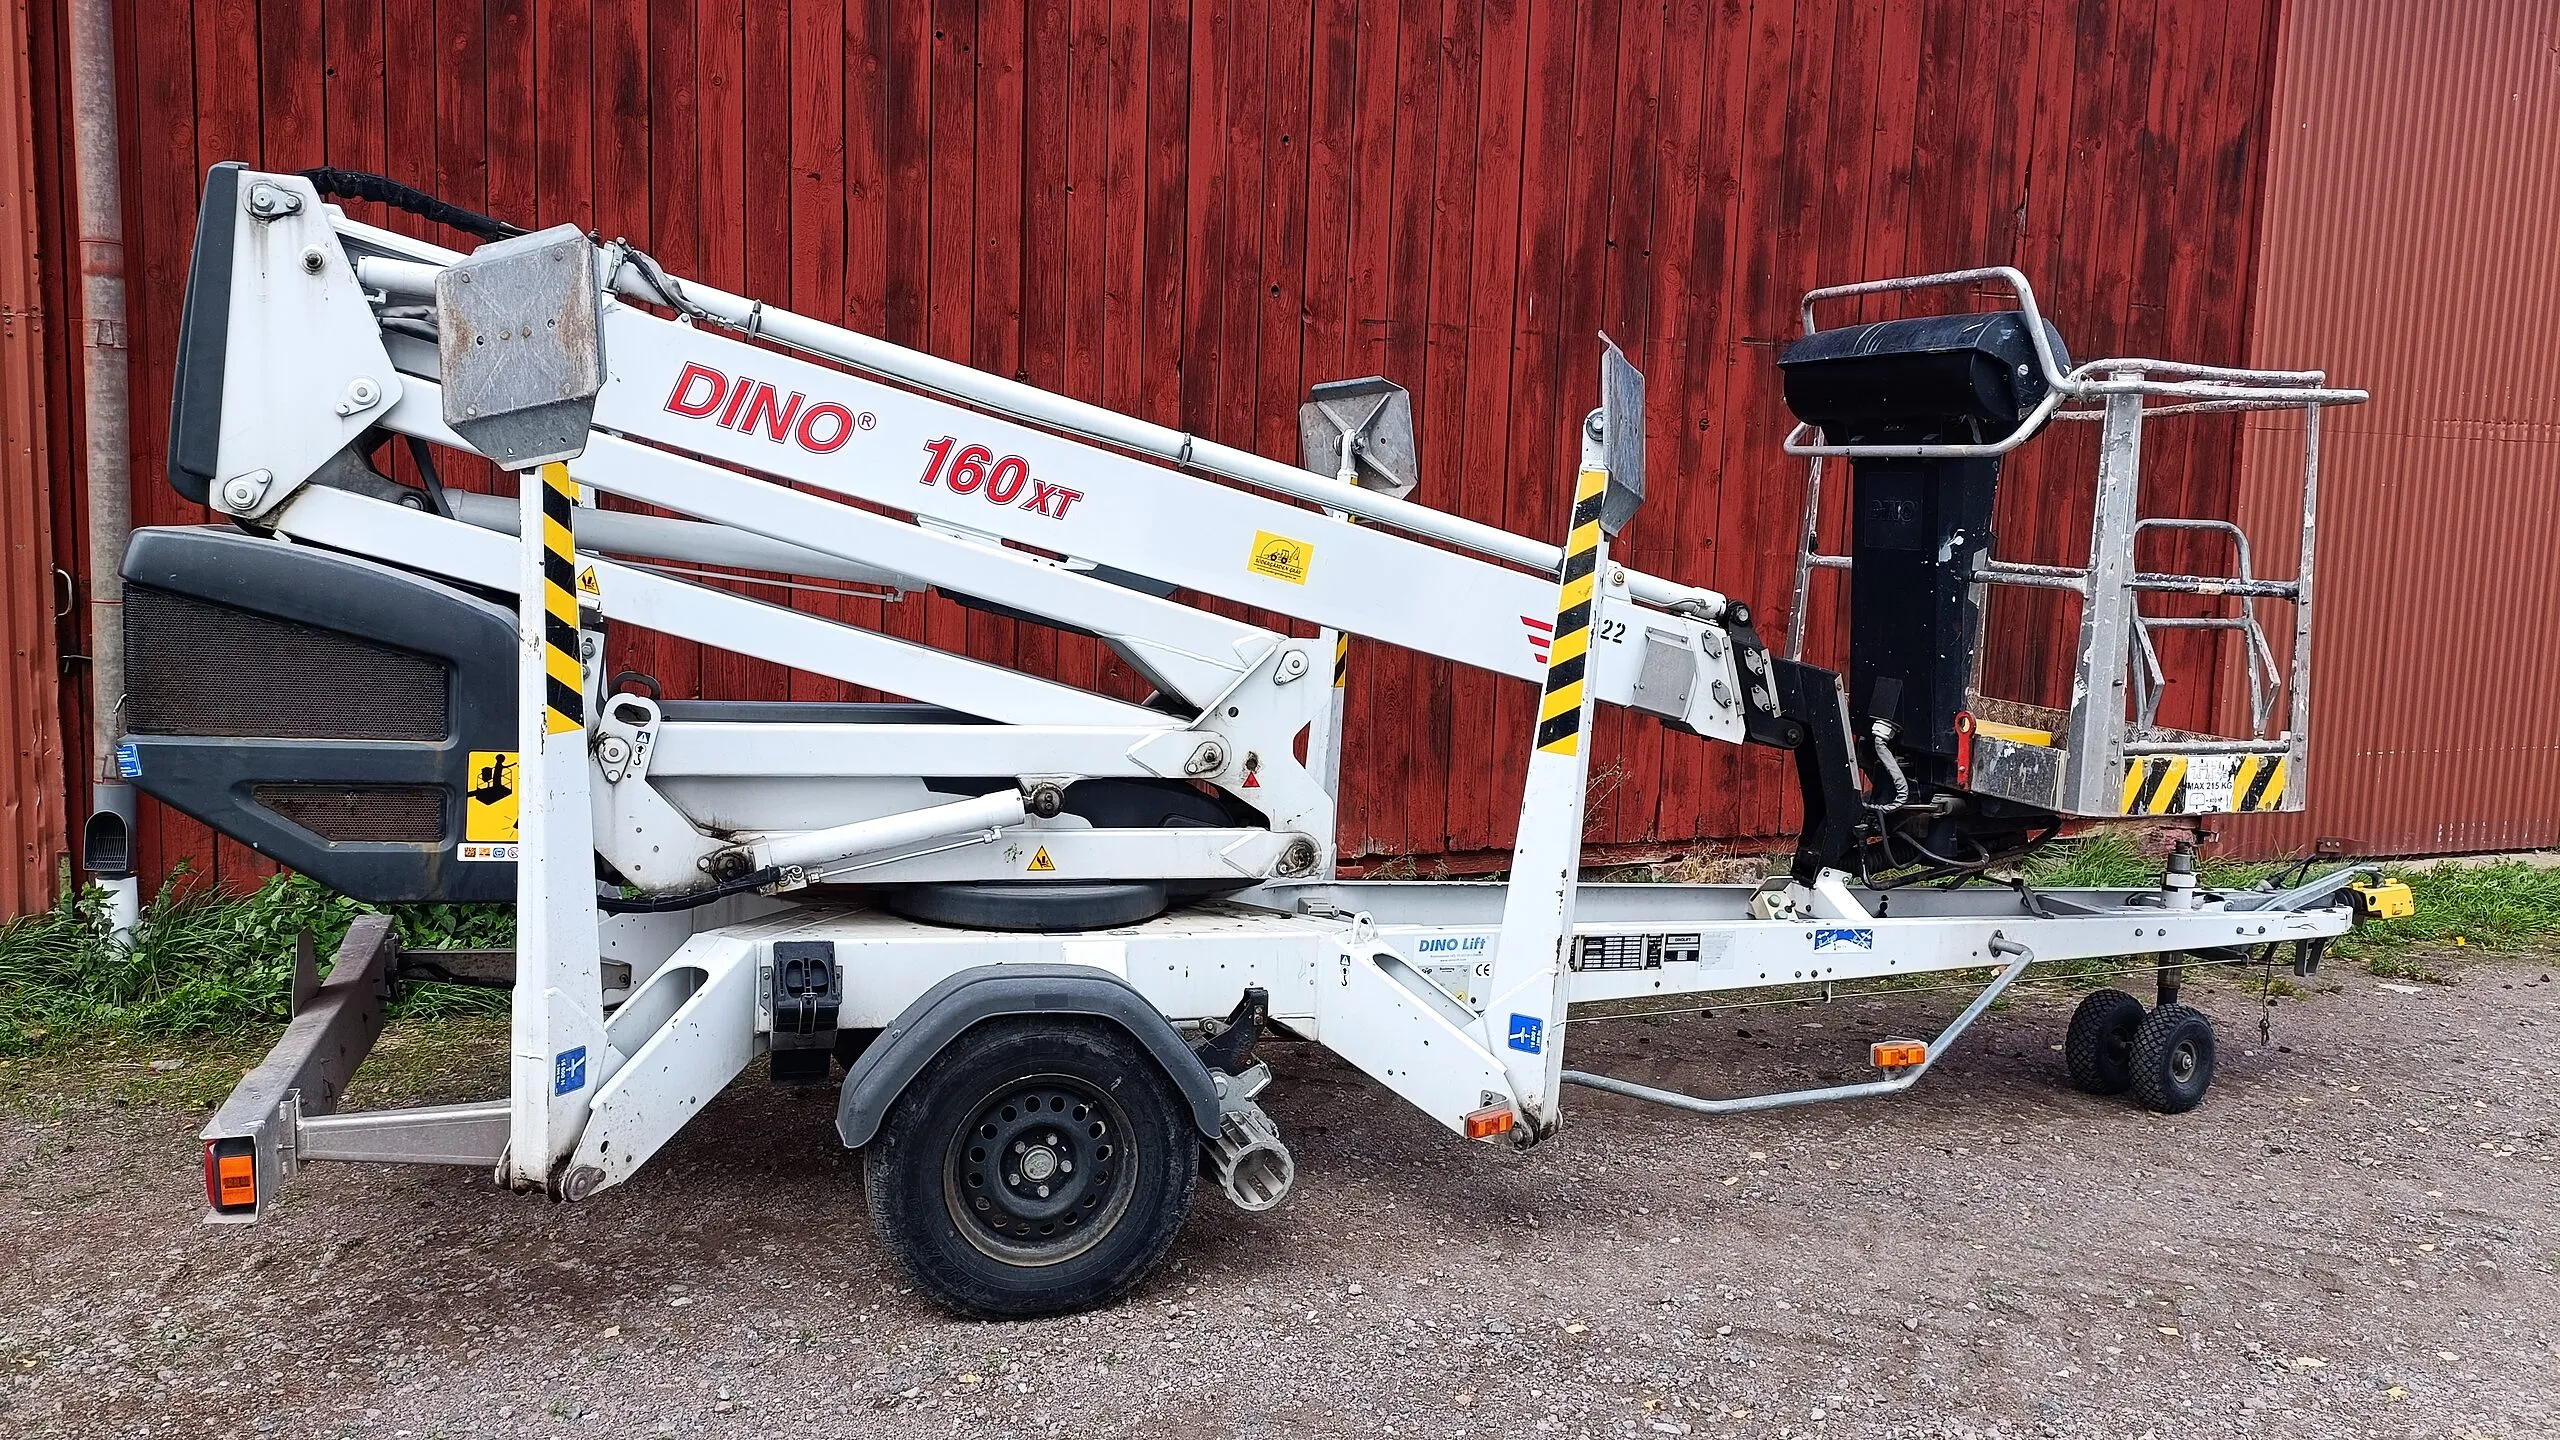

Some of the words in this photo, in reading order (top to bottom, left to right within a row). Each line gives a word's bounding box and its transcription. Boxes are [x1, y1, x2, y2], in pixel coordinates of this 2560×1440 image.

[2187, 782, 2205, 790] MAX
[2206, 781, 2220, 790] 215
[2221, 781, 2232, 790] KG
[1418, 938, 1459, 952] DINO
[1462, 936, 1486, 951] Lift
